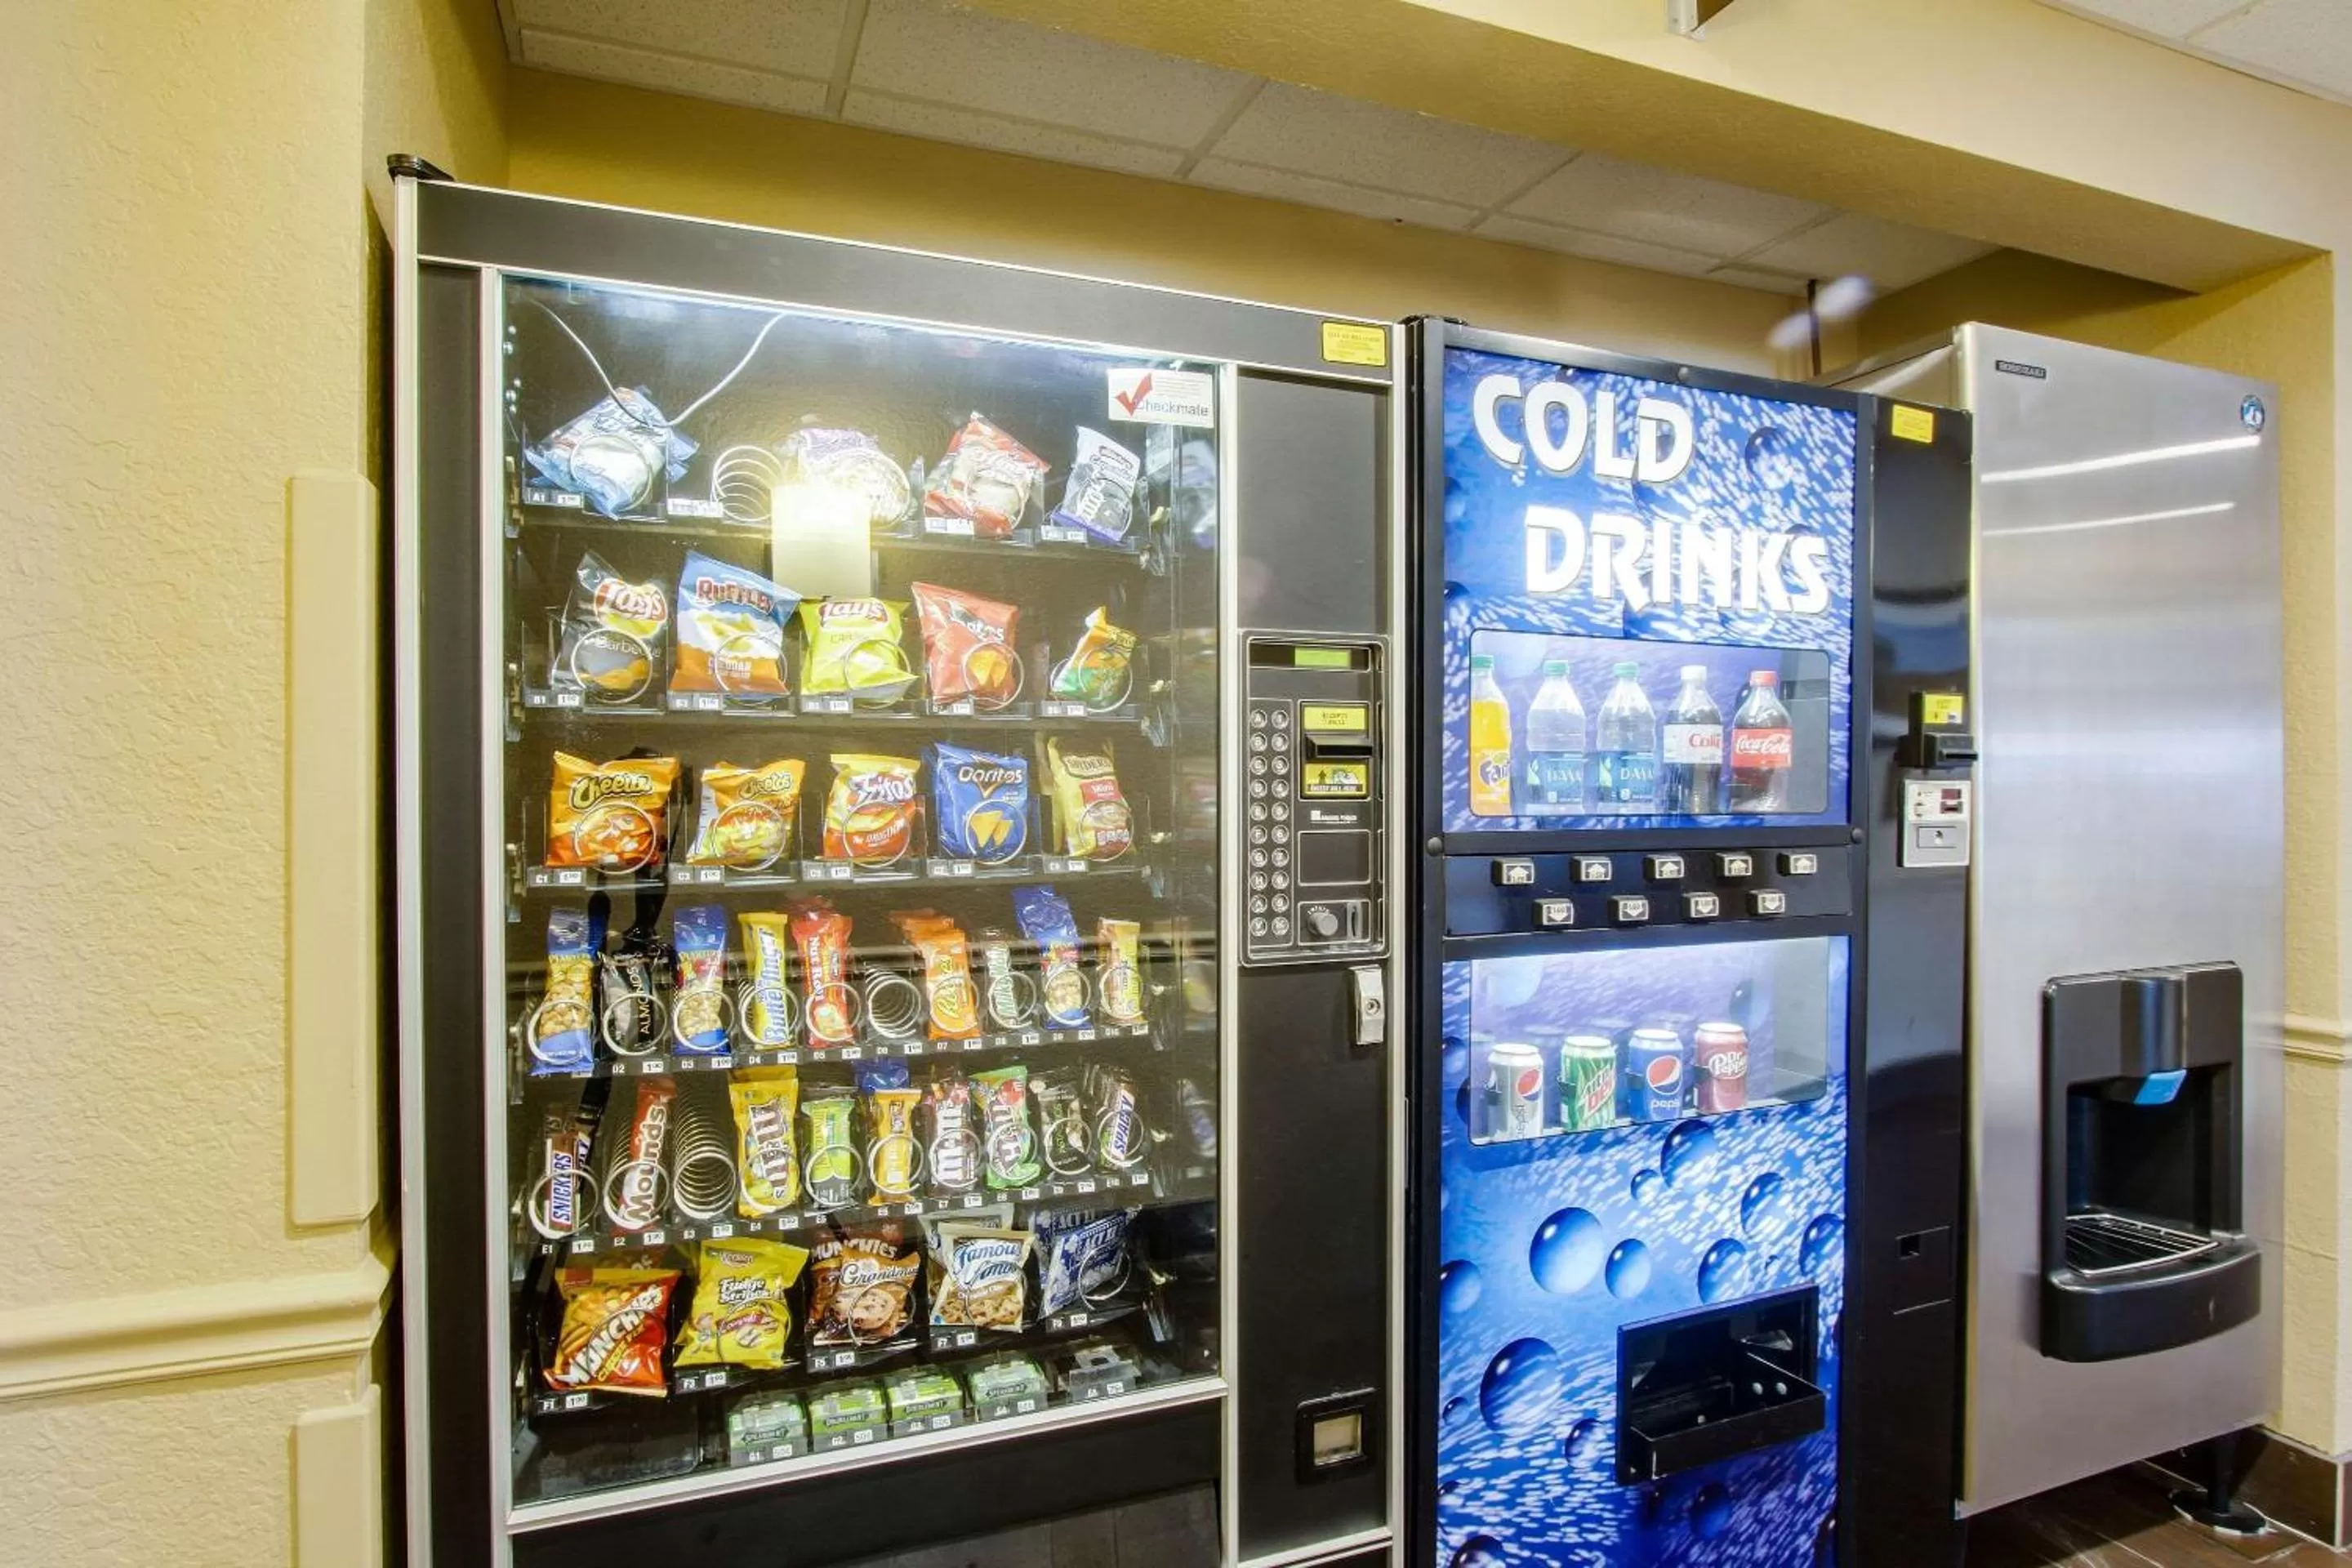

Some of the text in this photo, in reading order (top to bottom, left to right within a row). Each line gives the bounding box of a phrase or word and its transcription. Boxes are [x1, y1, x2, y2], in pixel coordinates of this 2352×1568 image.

[1472, 374, 1695, 483] COLD
[1525, 505, 1829, 614] DRINKS
[958, 765, 1022, 784] Doritos
[757, 928, 790, 1043] Buttefinger
[553, 1153, 572, 1224] SNICKERS
[621, 1105, 667, 1223] Mounds
